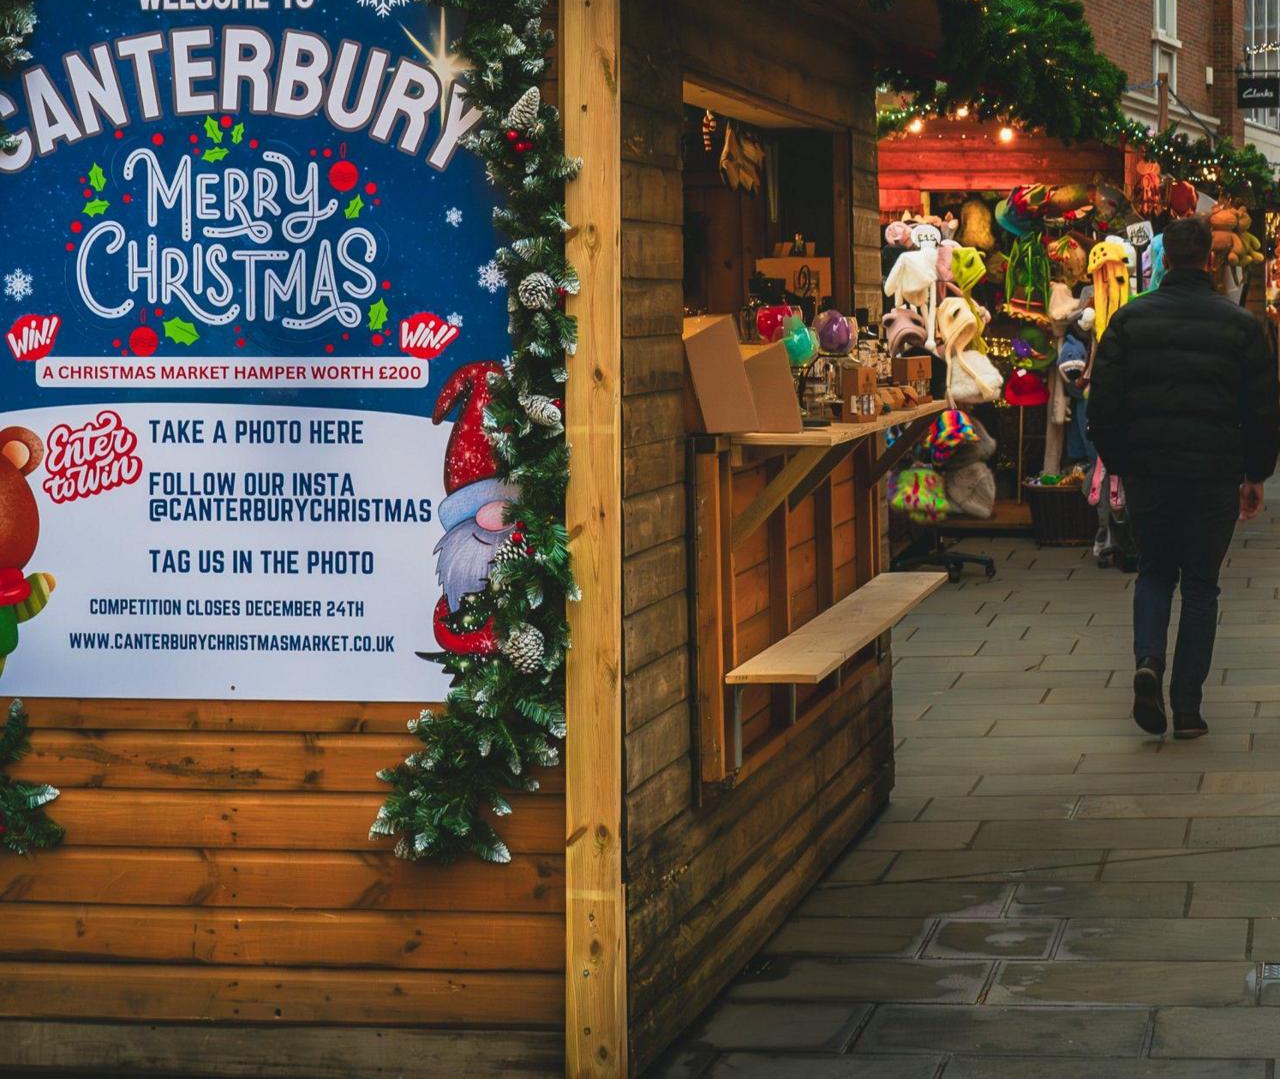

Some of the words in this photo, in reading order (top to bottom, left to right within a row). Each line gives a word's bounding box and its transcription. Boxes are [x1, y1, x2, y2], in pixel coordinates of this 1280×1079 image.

[1242, 87, 1274, 99] Clarks
[42, 366, 54, 380] A
[58, 366, 156, 380] CHRISTMAS
[160, 366, 230, 380] MARKET
[234, 366, 307, 380] HAMPER
[311, 366, 374, 380] WORTH
[378, 366, 422, 380] £200
[47, 411, 135, 474] Enter
[148, 420, 205, 444] TAKE
[212, 420, 227, 444] A
[235, 420, 302, 444] PHOTO
[309, 420, 364, 444] HERE
[148, 472, 236, 496] FOLLOW
[244, 472, 285, 497] OUR
[292, 472, 355, 497] INSTA
[148, 497, 432, 523] @CANTERBURYCHRISTMAS
[148, 549, 191, 574] TAG
[198, 550, 225, 574] US
[232, 550, 253, 574] IN
[260, 550, 299, 575] THE
[306, 550, 374, 575] PHOTO
[89, 598, 182, 616] COMPETITION
[186, 599, 241, 617] CLOSES
[245, 600, 322, 617] DECEMBER
[326, 600, 365, 617] 24TH
[69, 632, 395, 653] WWW.CANTERBURYCHRISTMASMARKET.CO.UK
